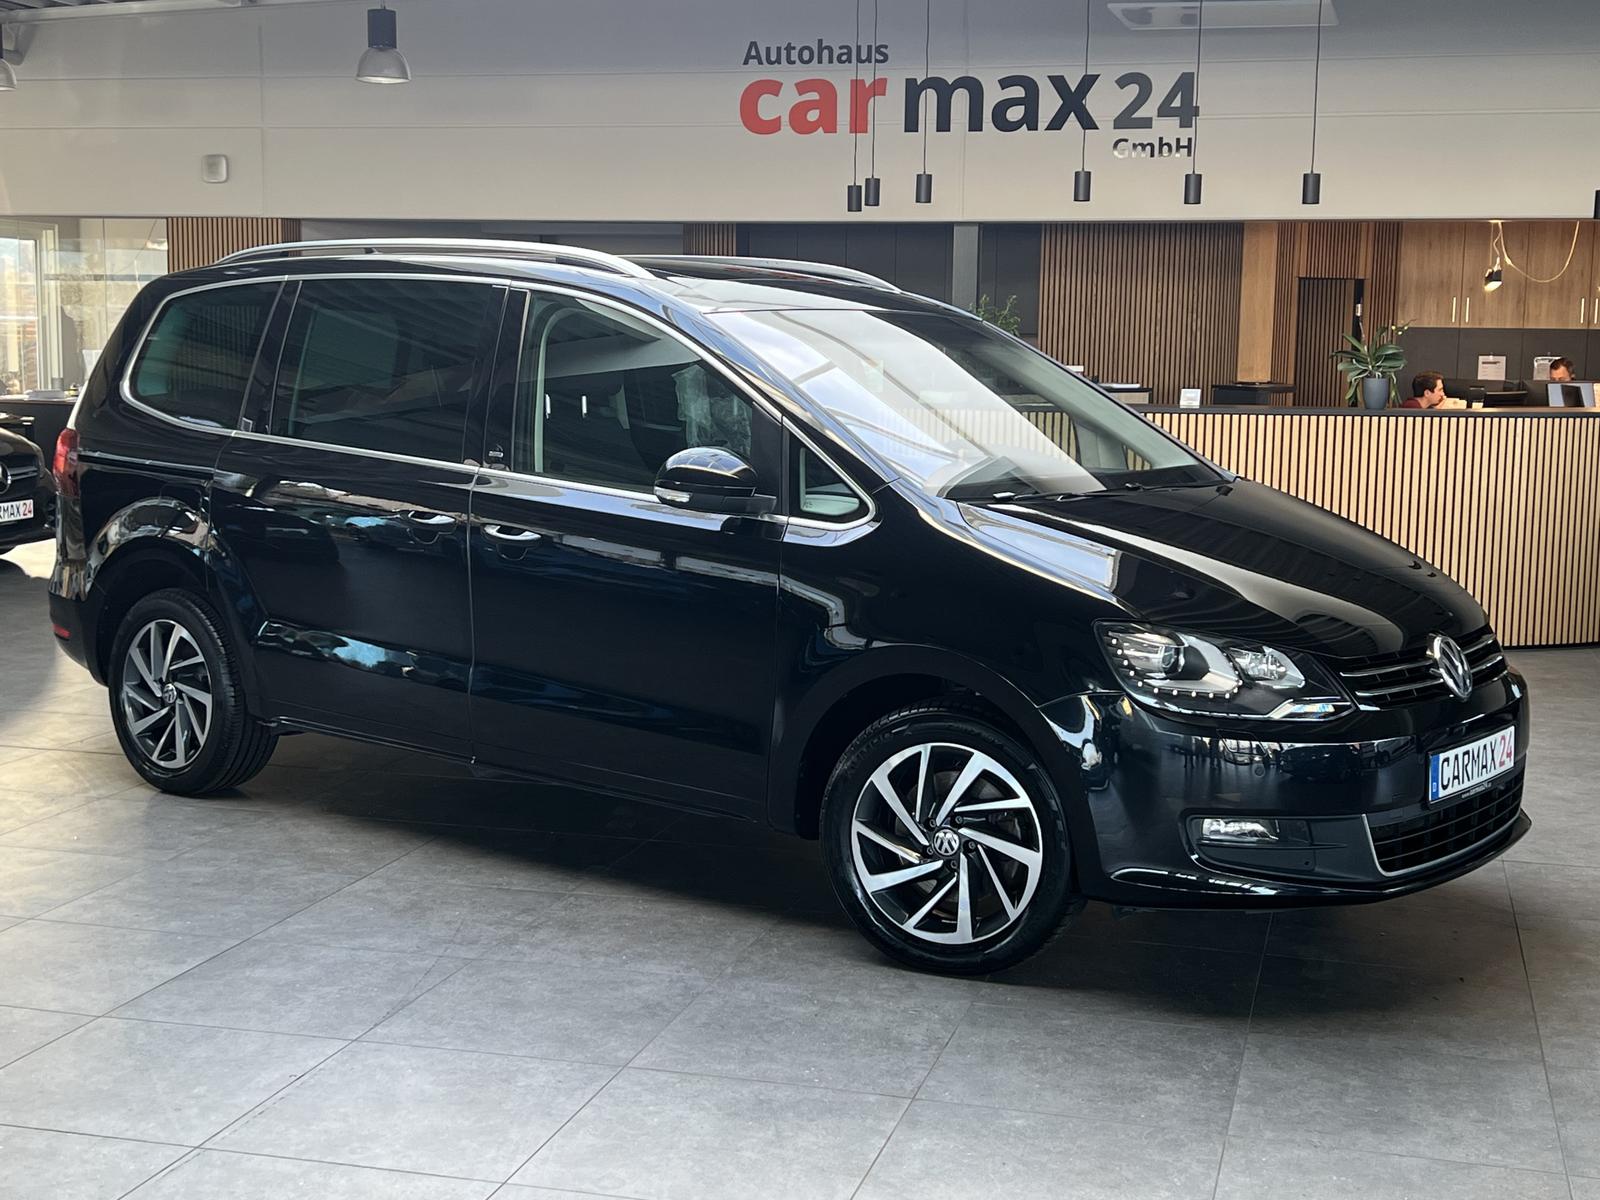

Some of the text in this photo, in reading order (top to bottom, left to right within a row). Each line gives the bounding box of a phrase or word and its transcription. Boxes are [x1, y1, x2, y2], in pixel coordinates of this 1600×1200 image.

[742, 38, 889, 66] Autohaus
[1113, 72, 1200, 129] 24
[1113, 137, 1193, 159] GmbH
